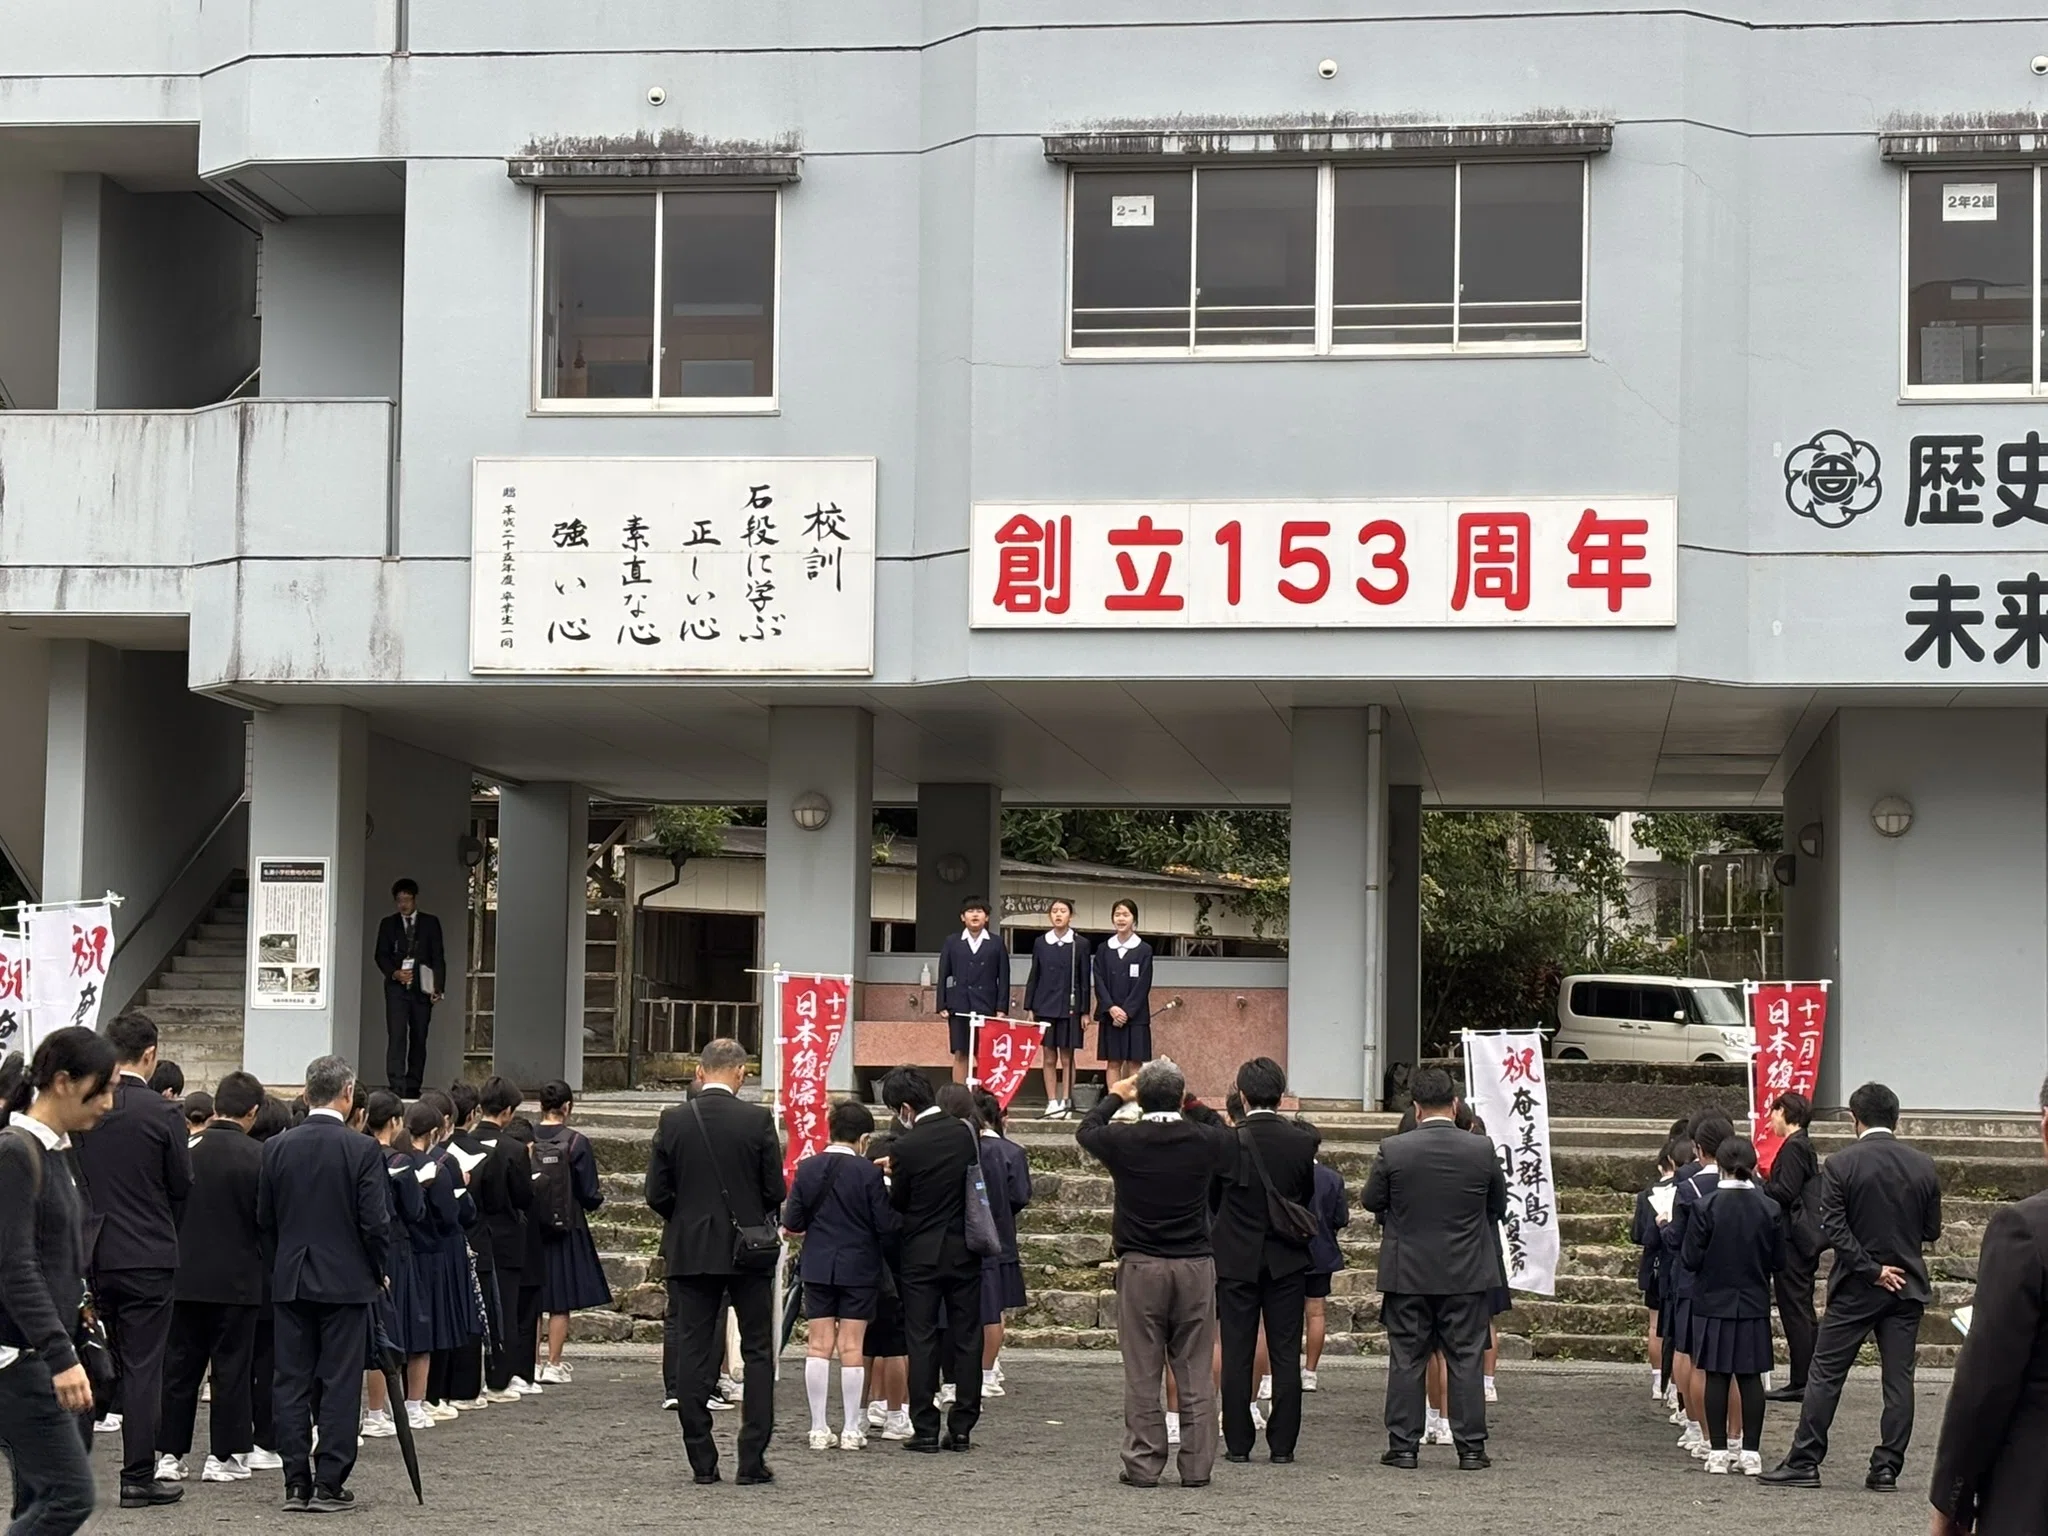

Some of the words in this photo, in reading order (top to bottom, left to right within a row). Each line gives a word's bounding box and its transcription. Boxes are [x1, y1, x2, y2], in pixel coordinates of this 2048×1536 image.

[1947, 194, 1995, 209] 2年2組
[1904, 430, 2048, 528] 歴史
[501, 504, 516, 586] 平成二十五年度
[547, 518, 591, 644] 強い心
[617, 515, 661, 646] 素直な心
[679, 520, 721, 642] 正しい心
[739, 485, 786, 643] 石段に学ぶ
[802, 502, 851, 593] 校訓
[992, 507, 1652, 615] 創立153周年
[500, 591, 516, 649] 卒業生一同
[1904, 571, 2048, 669] 未来
[69, 924, 108, 978] 祝
[985, 1034, 1012, 1098] 日本
[1500, 1047, 1541, 1084] 祝
[1508, 1086, 1550, 1228] 奄美群島
